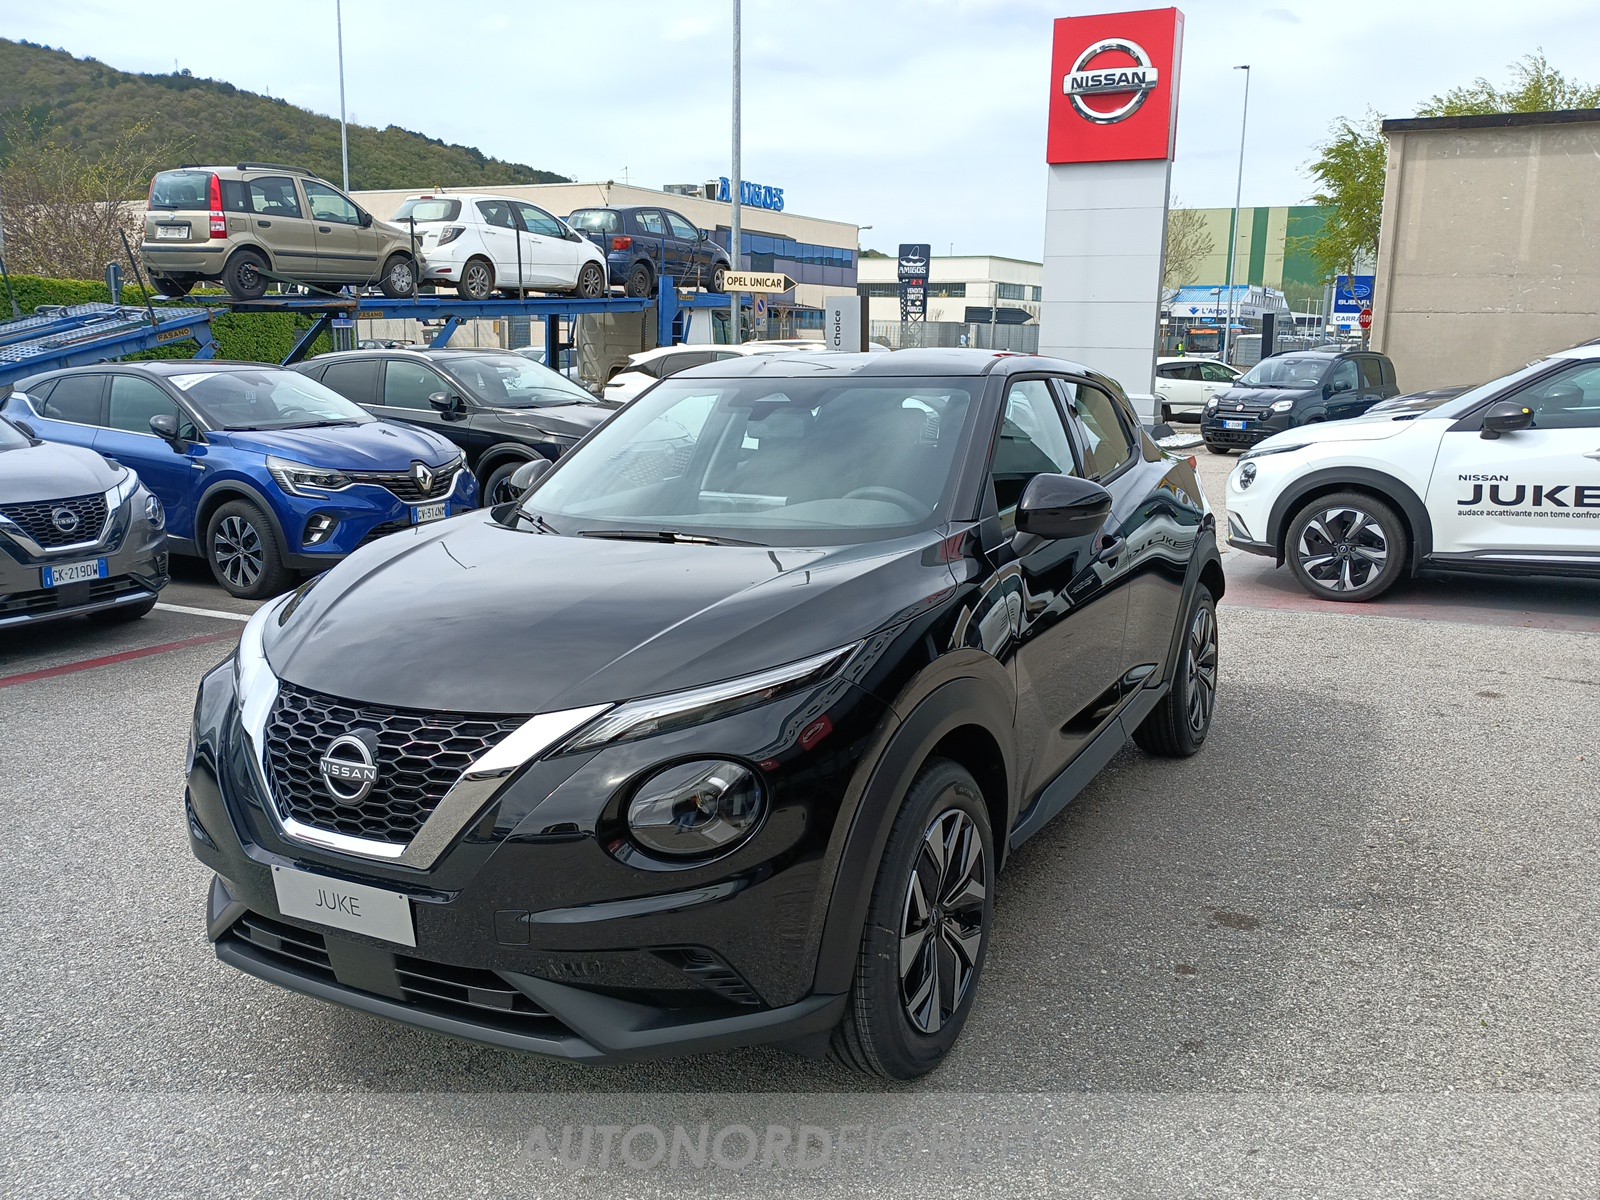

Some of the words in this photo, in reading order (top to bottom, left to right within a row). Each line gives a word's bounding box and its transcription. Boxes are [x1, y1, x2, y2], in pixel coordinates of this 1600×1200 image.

[1071, 71, 1146, 91] NISSAN
[898, 266, 926, 275] AMIGOS
[726, 276, 748, 287] OPEL
[750, 277, 782, 288] UNICAR
[1202, 307, 1234, 315] L'Angoo
[1360, 314, 1372, 323] STOP
[157, 328, 190, 341] FASANO
[833, 310, 841, 347] Choice
[1458, 474, 1509, 482] NISSAN
[1457, 484, 1600, 508] JUKE
[1486, 509, 1533, 517] accattivante
[52, 563, 98, 583] GK-219DW
[319, 761, 376, 780] NISSAN
[315, 888, 363, 918] JUKE
